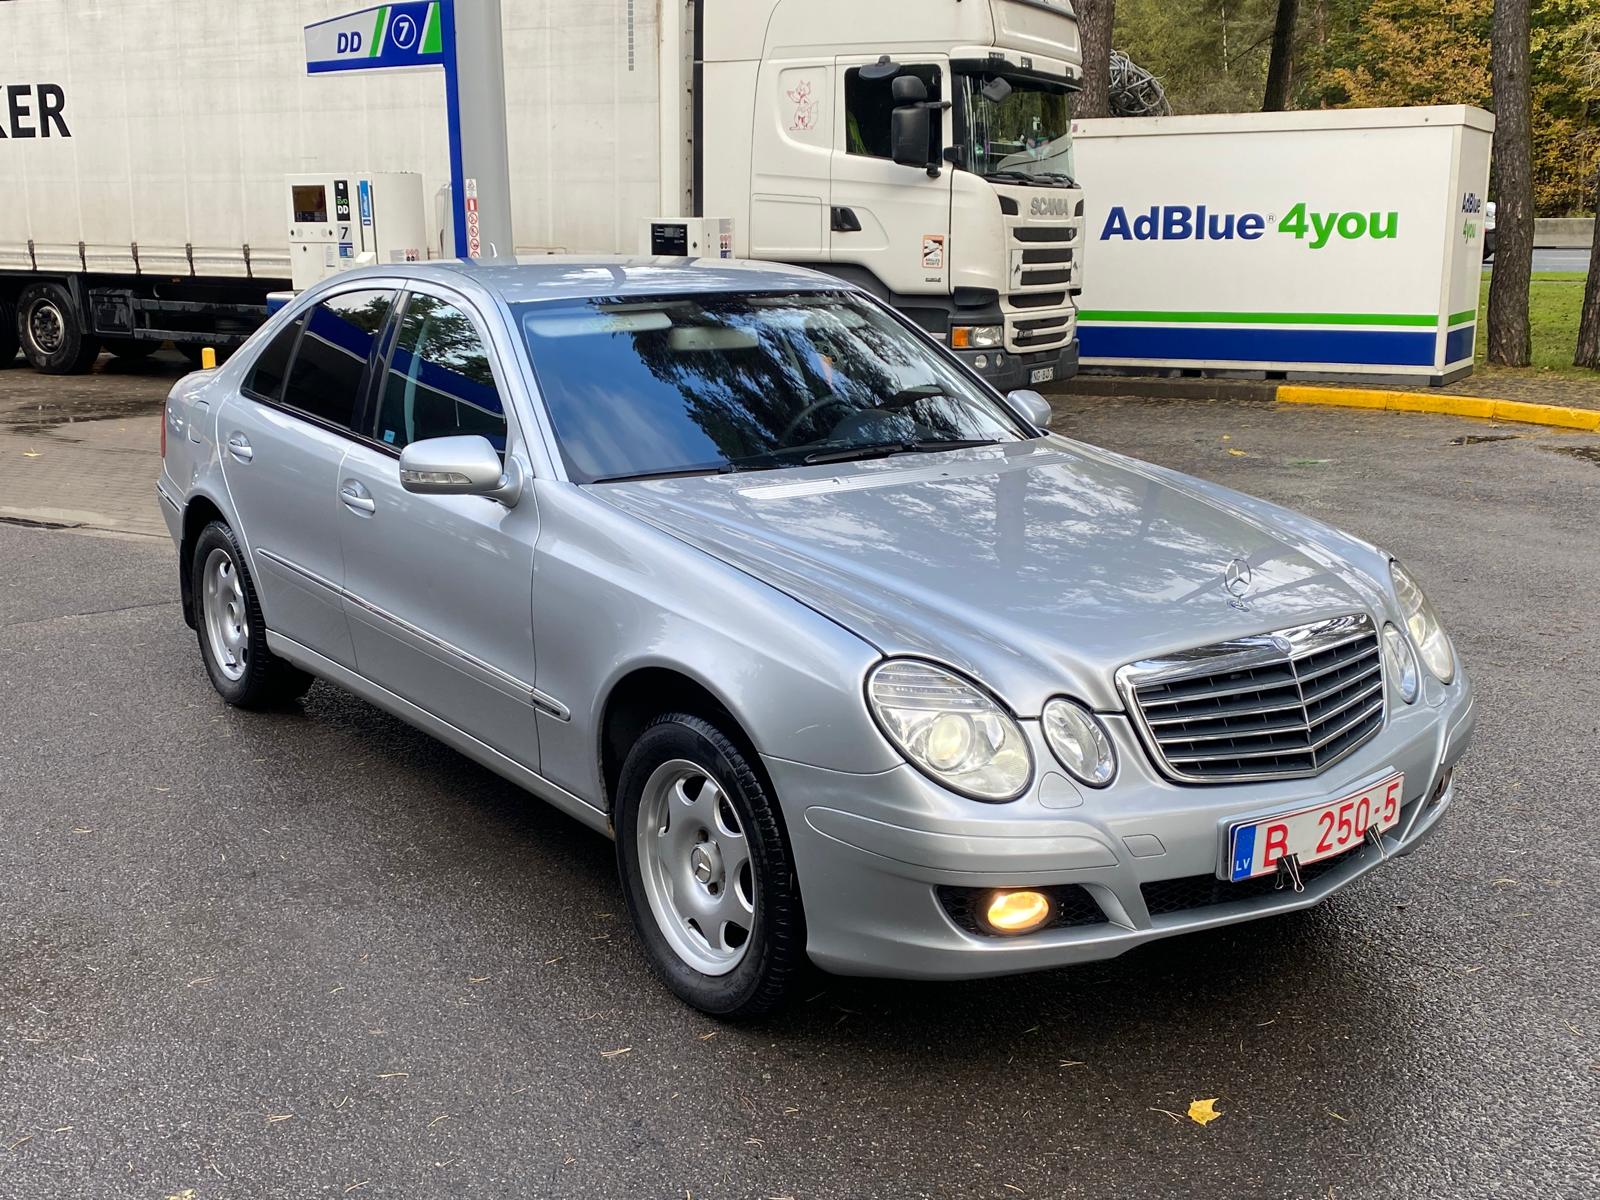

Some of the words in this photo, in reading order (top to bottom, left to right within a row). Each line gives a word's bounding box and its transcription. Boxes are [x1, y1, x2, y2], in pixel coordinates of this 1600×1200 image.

[337, 31, 362, 54] DD
[399, 21, 410, 42] 7
[0, 84, 72, 139] ER
[337, 205, 349, 215] DD
[1030, 197, 1069, 216] SCANIA
[1462, 192, 1481, 214] AdBlue
[341, 226, 349, 240] 7
[1278, 202, 1399, 249] 4you
[1462, 217, 1477, 244] 4you
[1263, 823, 1289, 868] B
[1315, 782, 1400, 854] 250-5
[1235, 857, 1251, 872] LV
